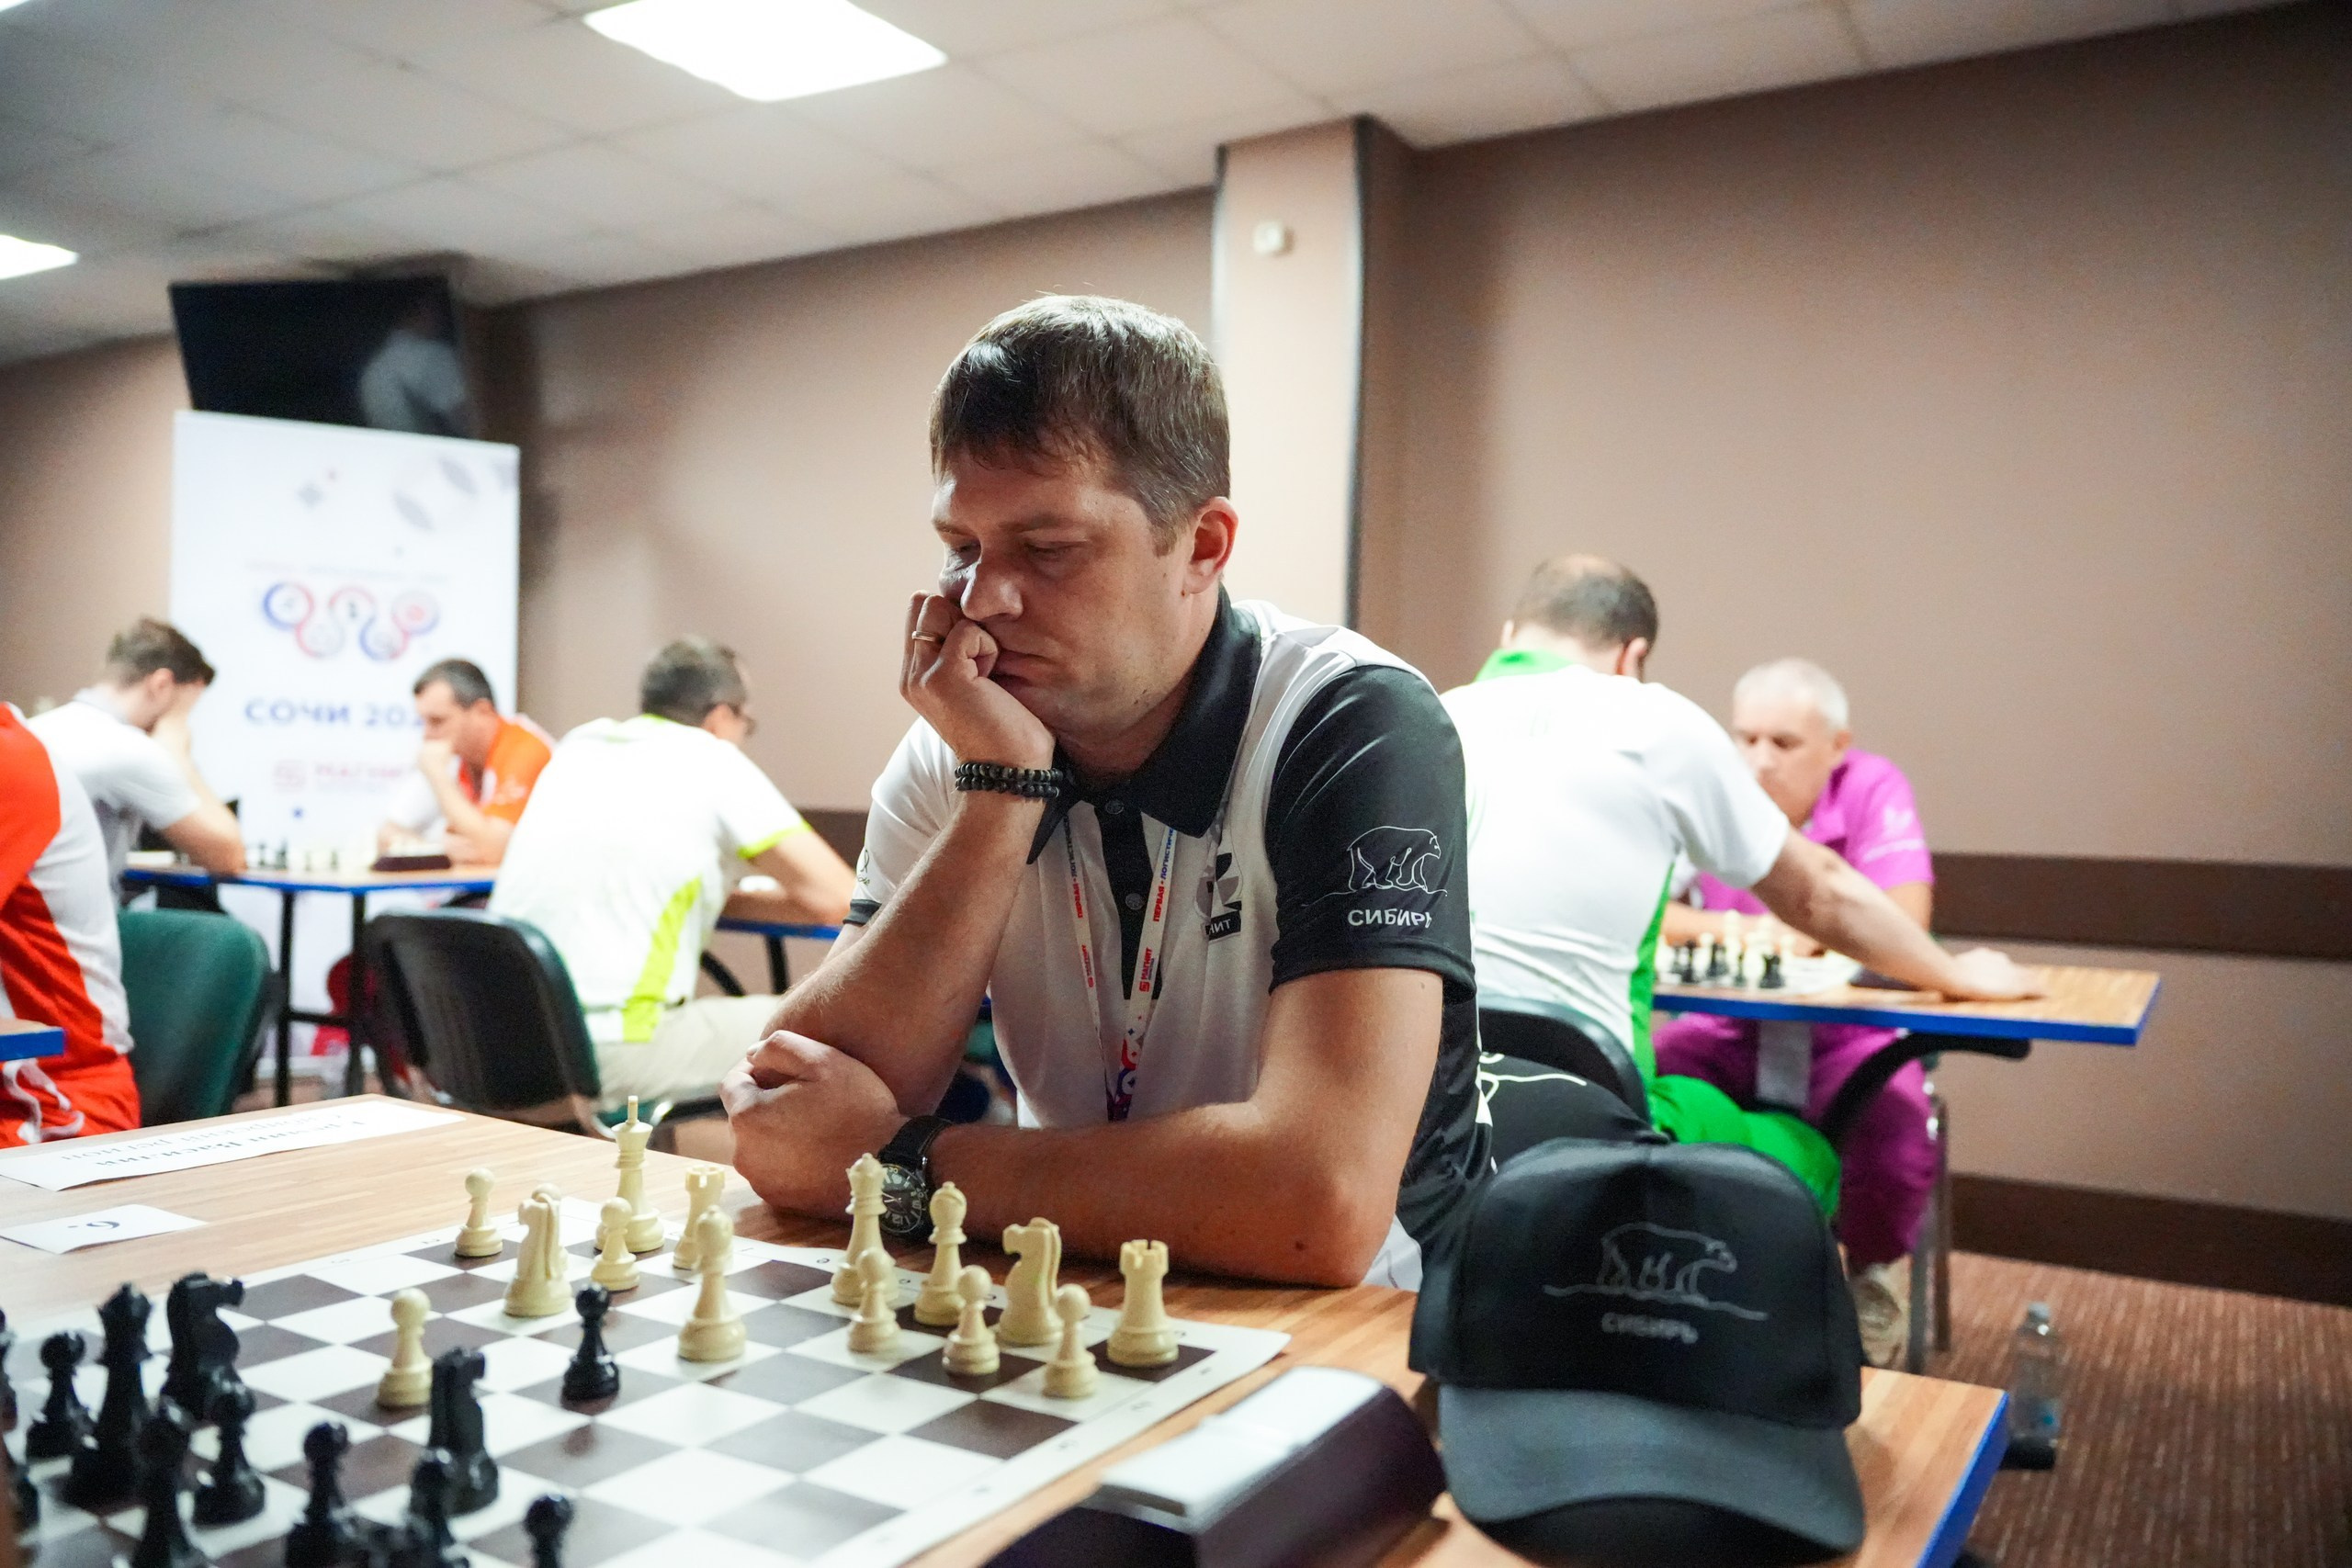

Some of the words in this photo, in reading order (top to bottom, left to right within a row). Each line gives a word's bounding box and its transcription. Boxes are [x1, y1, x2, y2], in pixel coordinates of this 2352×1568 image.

[244, 698, 351, 726] СОЧИ
[364, 701, 424, 728] 20
[1152, 886, 1165, 922] ПЕРВАЯ
